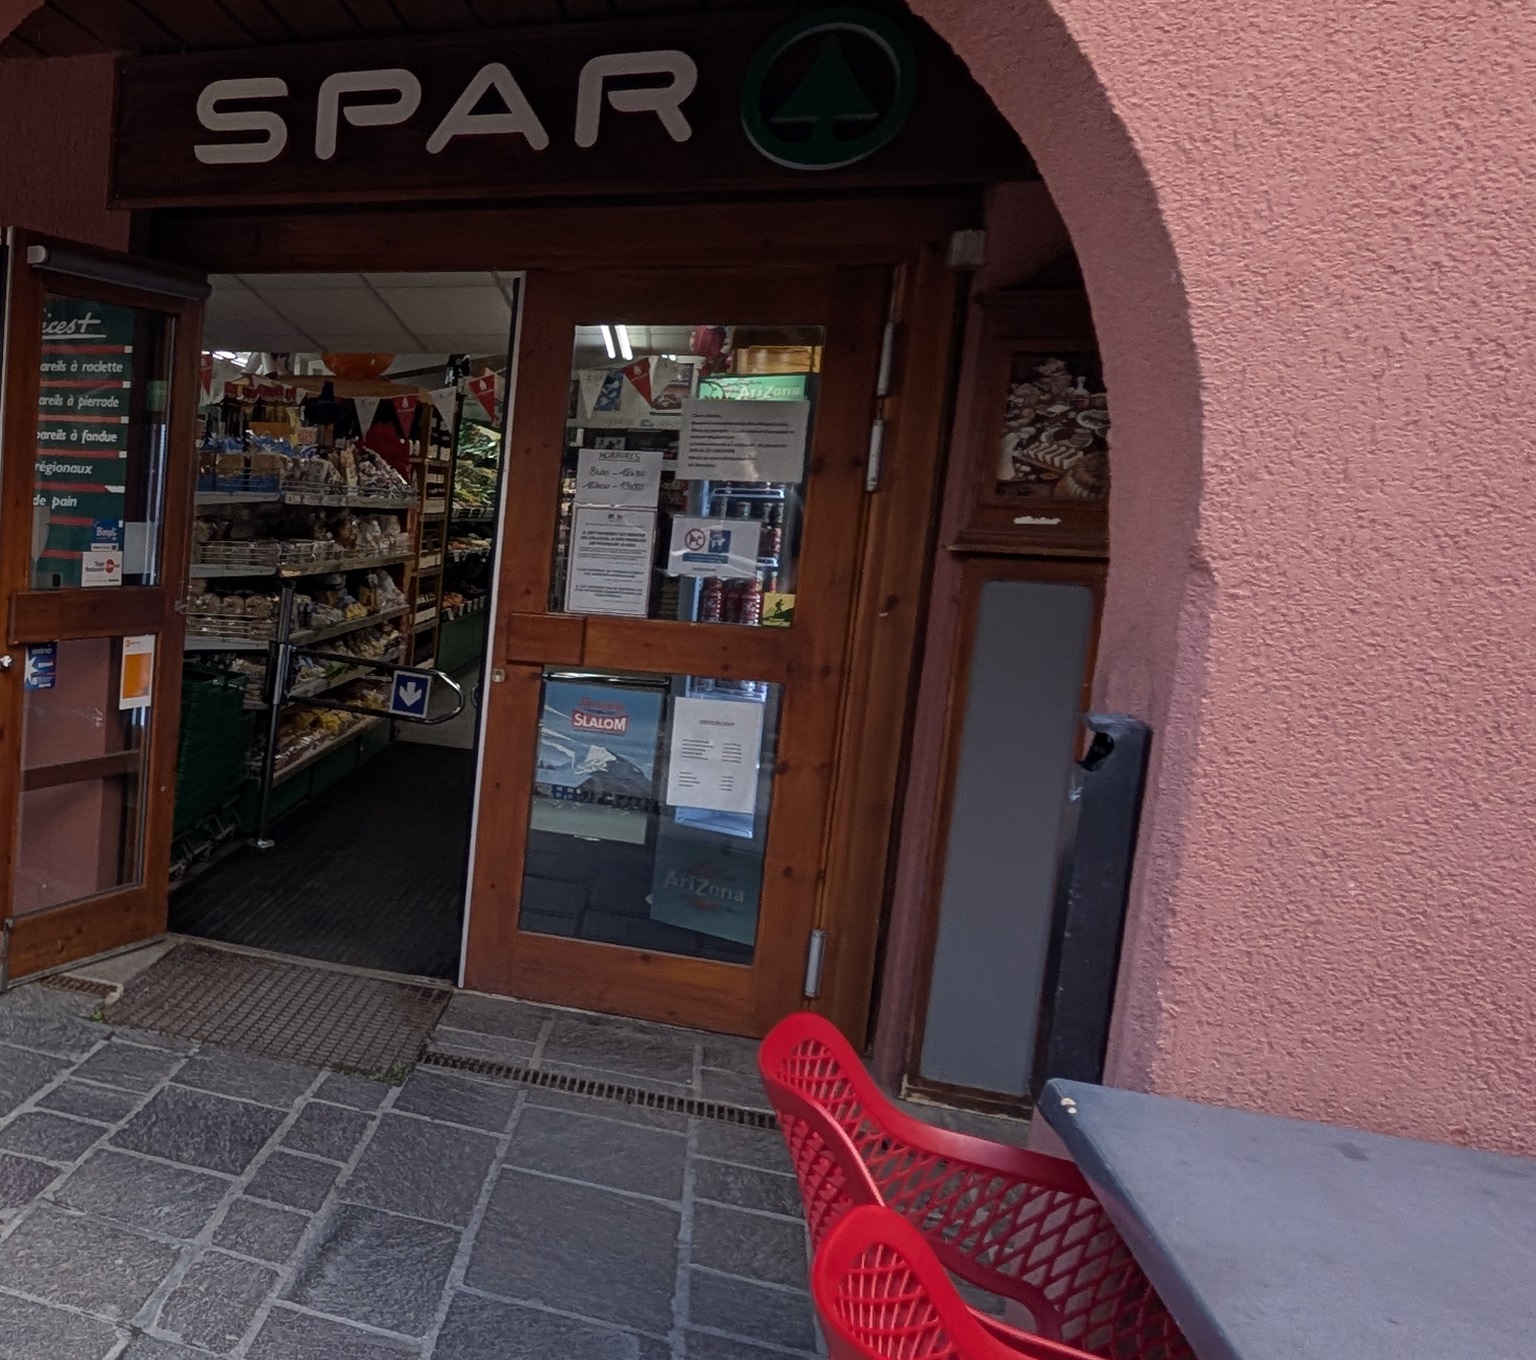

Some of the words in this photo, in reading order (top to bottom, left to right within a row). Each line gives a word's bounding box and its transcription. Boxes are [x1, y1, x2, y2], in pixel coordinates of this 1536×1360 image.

[194, 49, 698, 165] SPAR
[70, 360, 78, 372] à
[81, 360, 123, 373] raclette
[67, 394, 74, 407] à
[77, 395, 119, 410] pierrade
[70, 429, 78, 441] à
[81, 429, 118, 444] fondue
[35, 461, 93, 476] régionaux
[51, 495, 78, 510] pain
[573, 712, 627, 732] SLALOM
